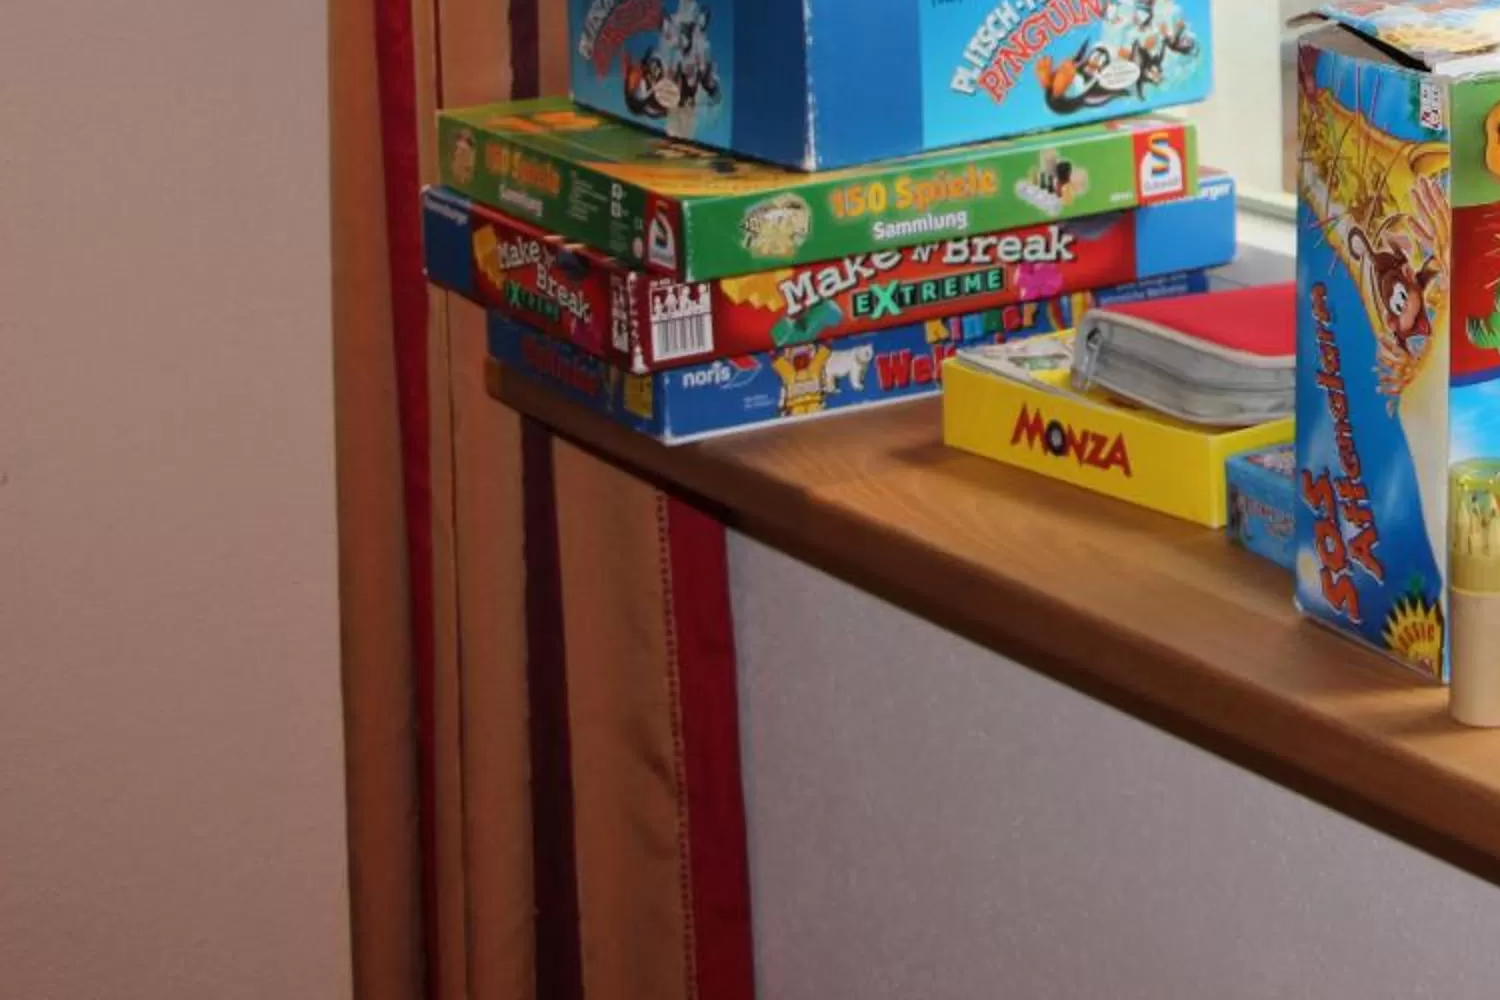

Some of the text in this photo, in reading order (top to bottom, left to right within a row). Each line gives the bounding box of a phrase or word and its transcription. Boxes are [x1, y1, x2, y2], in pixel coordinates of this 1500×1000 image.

[829, 163, 999, 218] 150 Spiele
[497, 236, 540, 268] Make
[872, 210, 968, 243] Sammlung
[536, 266, 592, 324] Break
[780, 245, 903, 316] Make
[942, 227, 1075, 264] Break
[854, 268, 1003, 318] EXTREME
[682, 358, 731, 389] noris
[1011, 402, 1132, 478] MONZA
